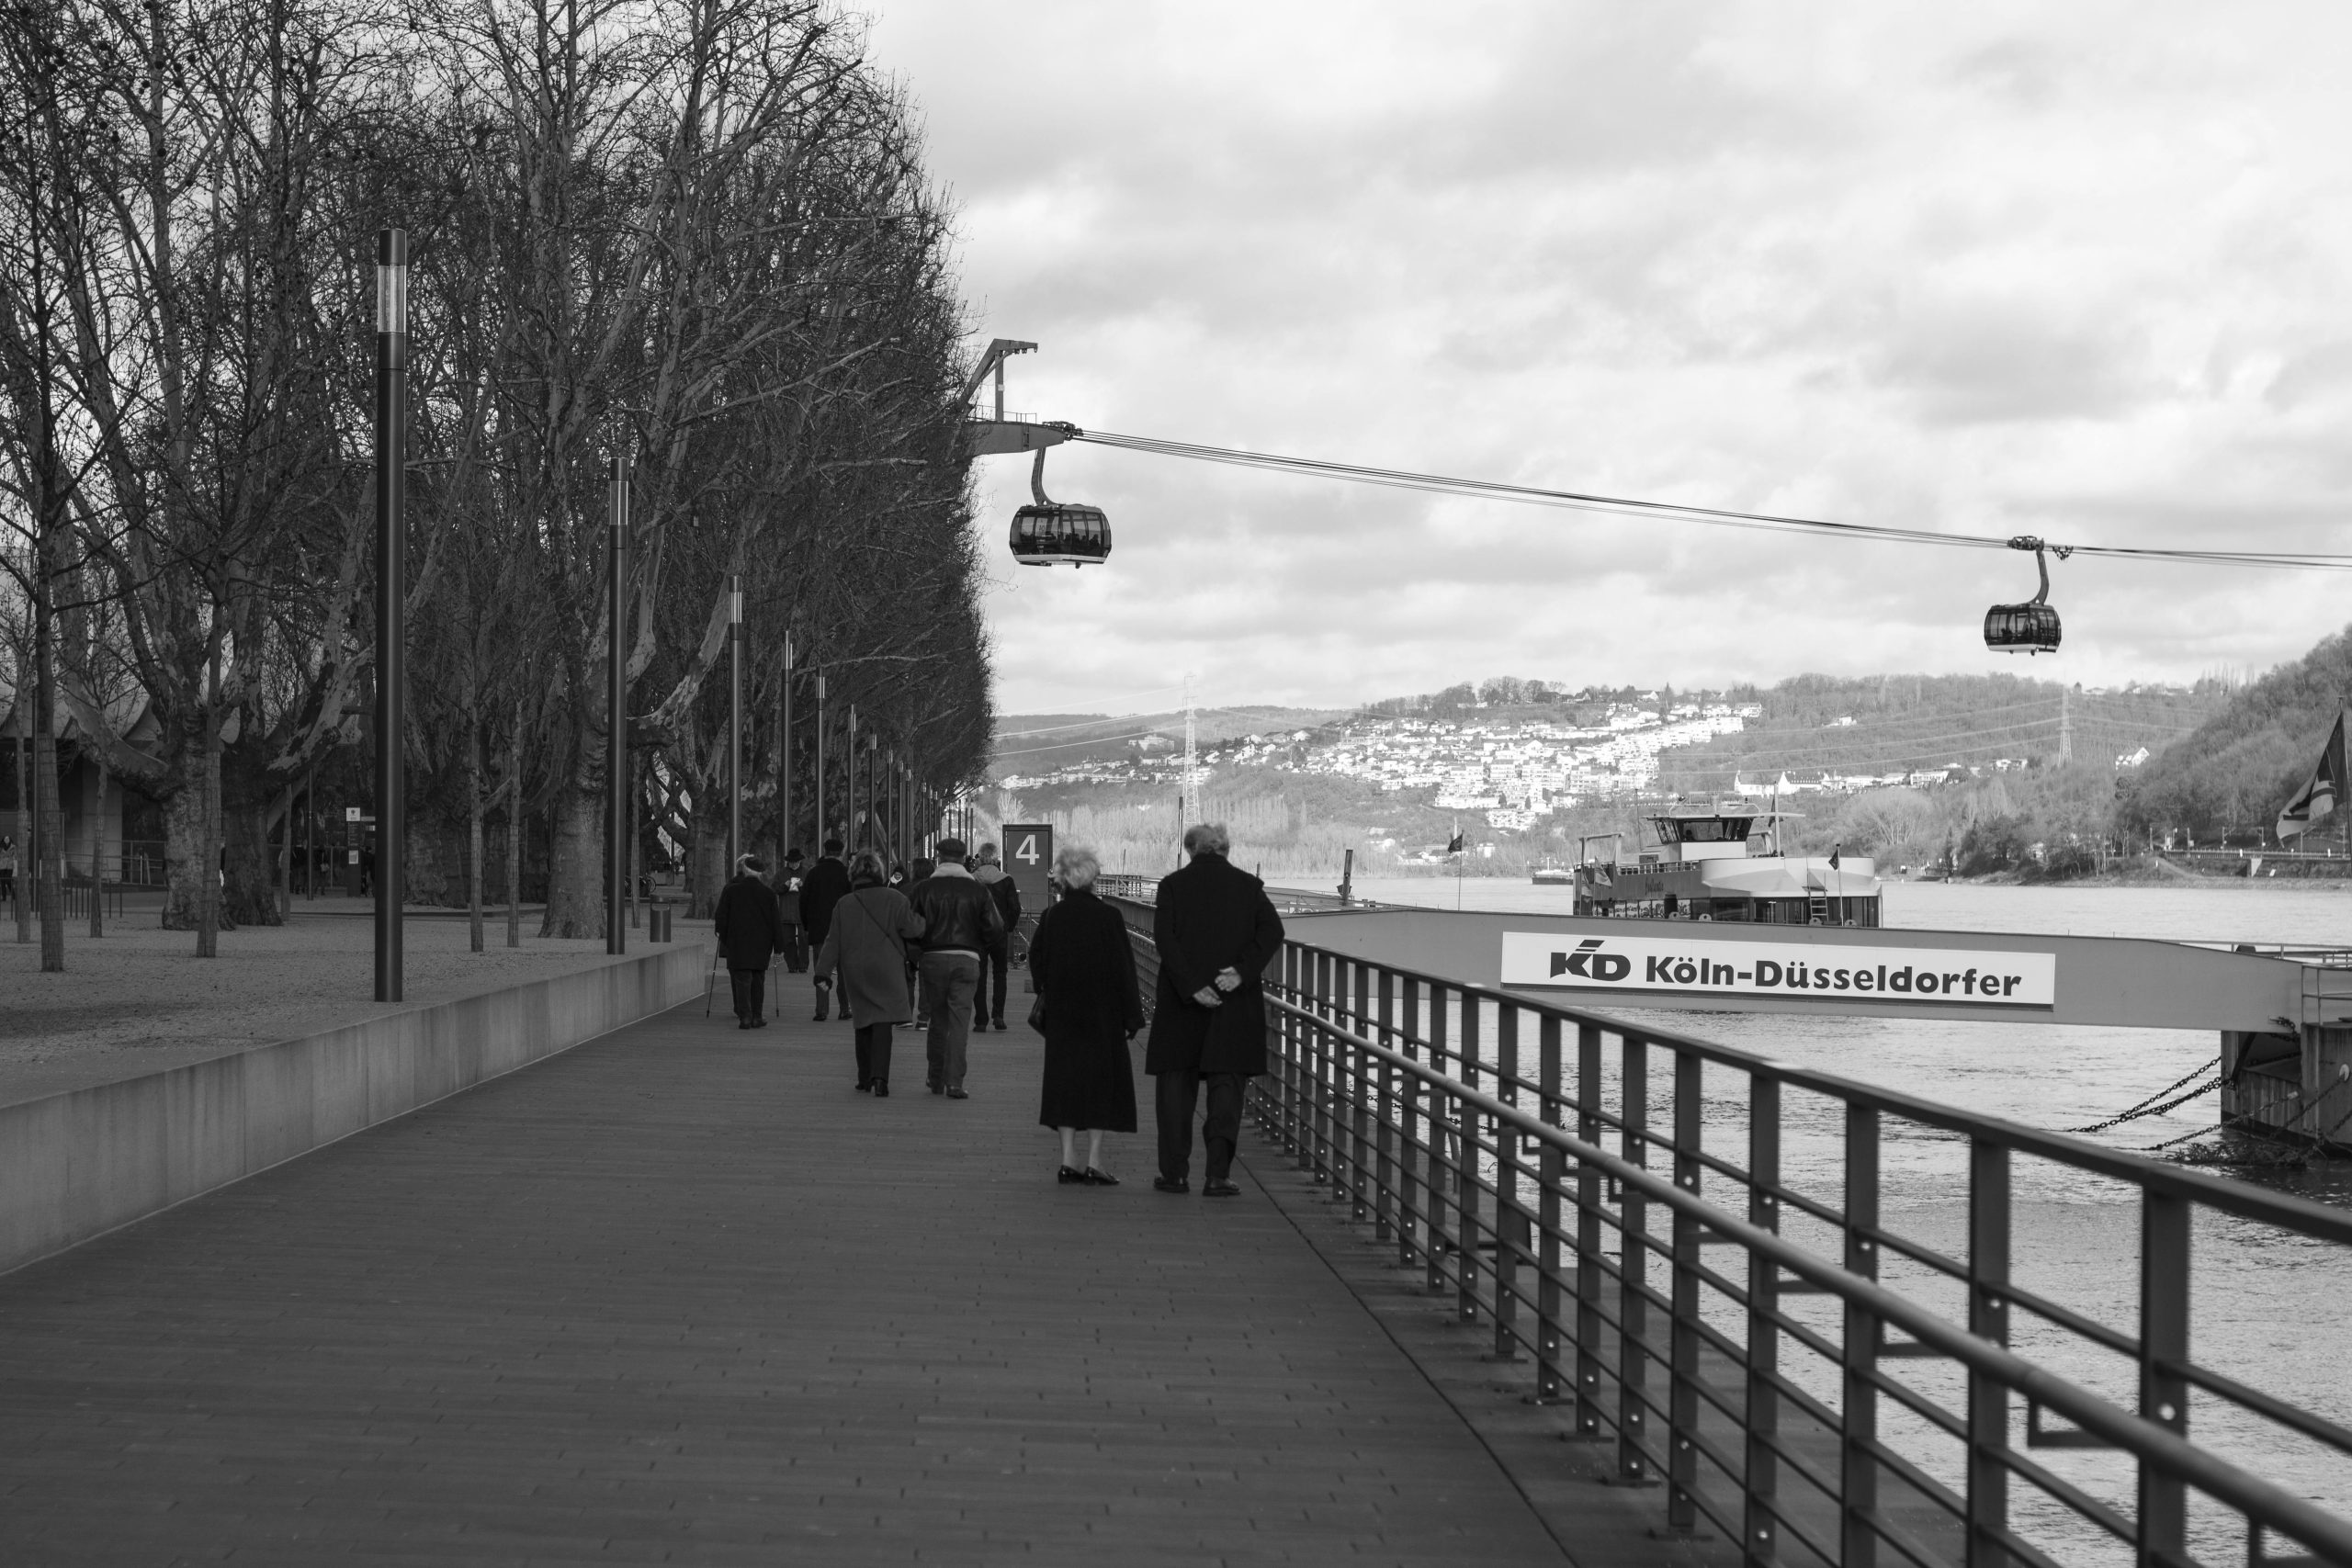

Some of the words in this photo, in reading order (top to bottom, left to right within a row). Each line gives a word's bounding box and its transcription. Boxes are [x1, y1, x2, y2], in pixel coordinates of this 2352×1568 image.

[1015, 834, 1040, 865] 4
[1549, 939, 1632, 982] KD
[1645, 955, 2022, 997] Köln-Düsseldorfer
